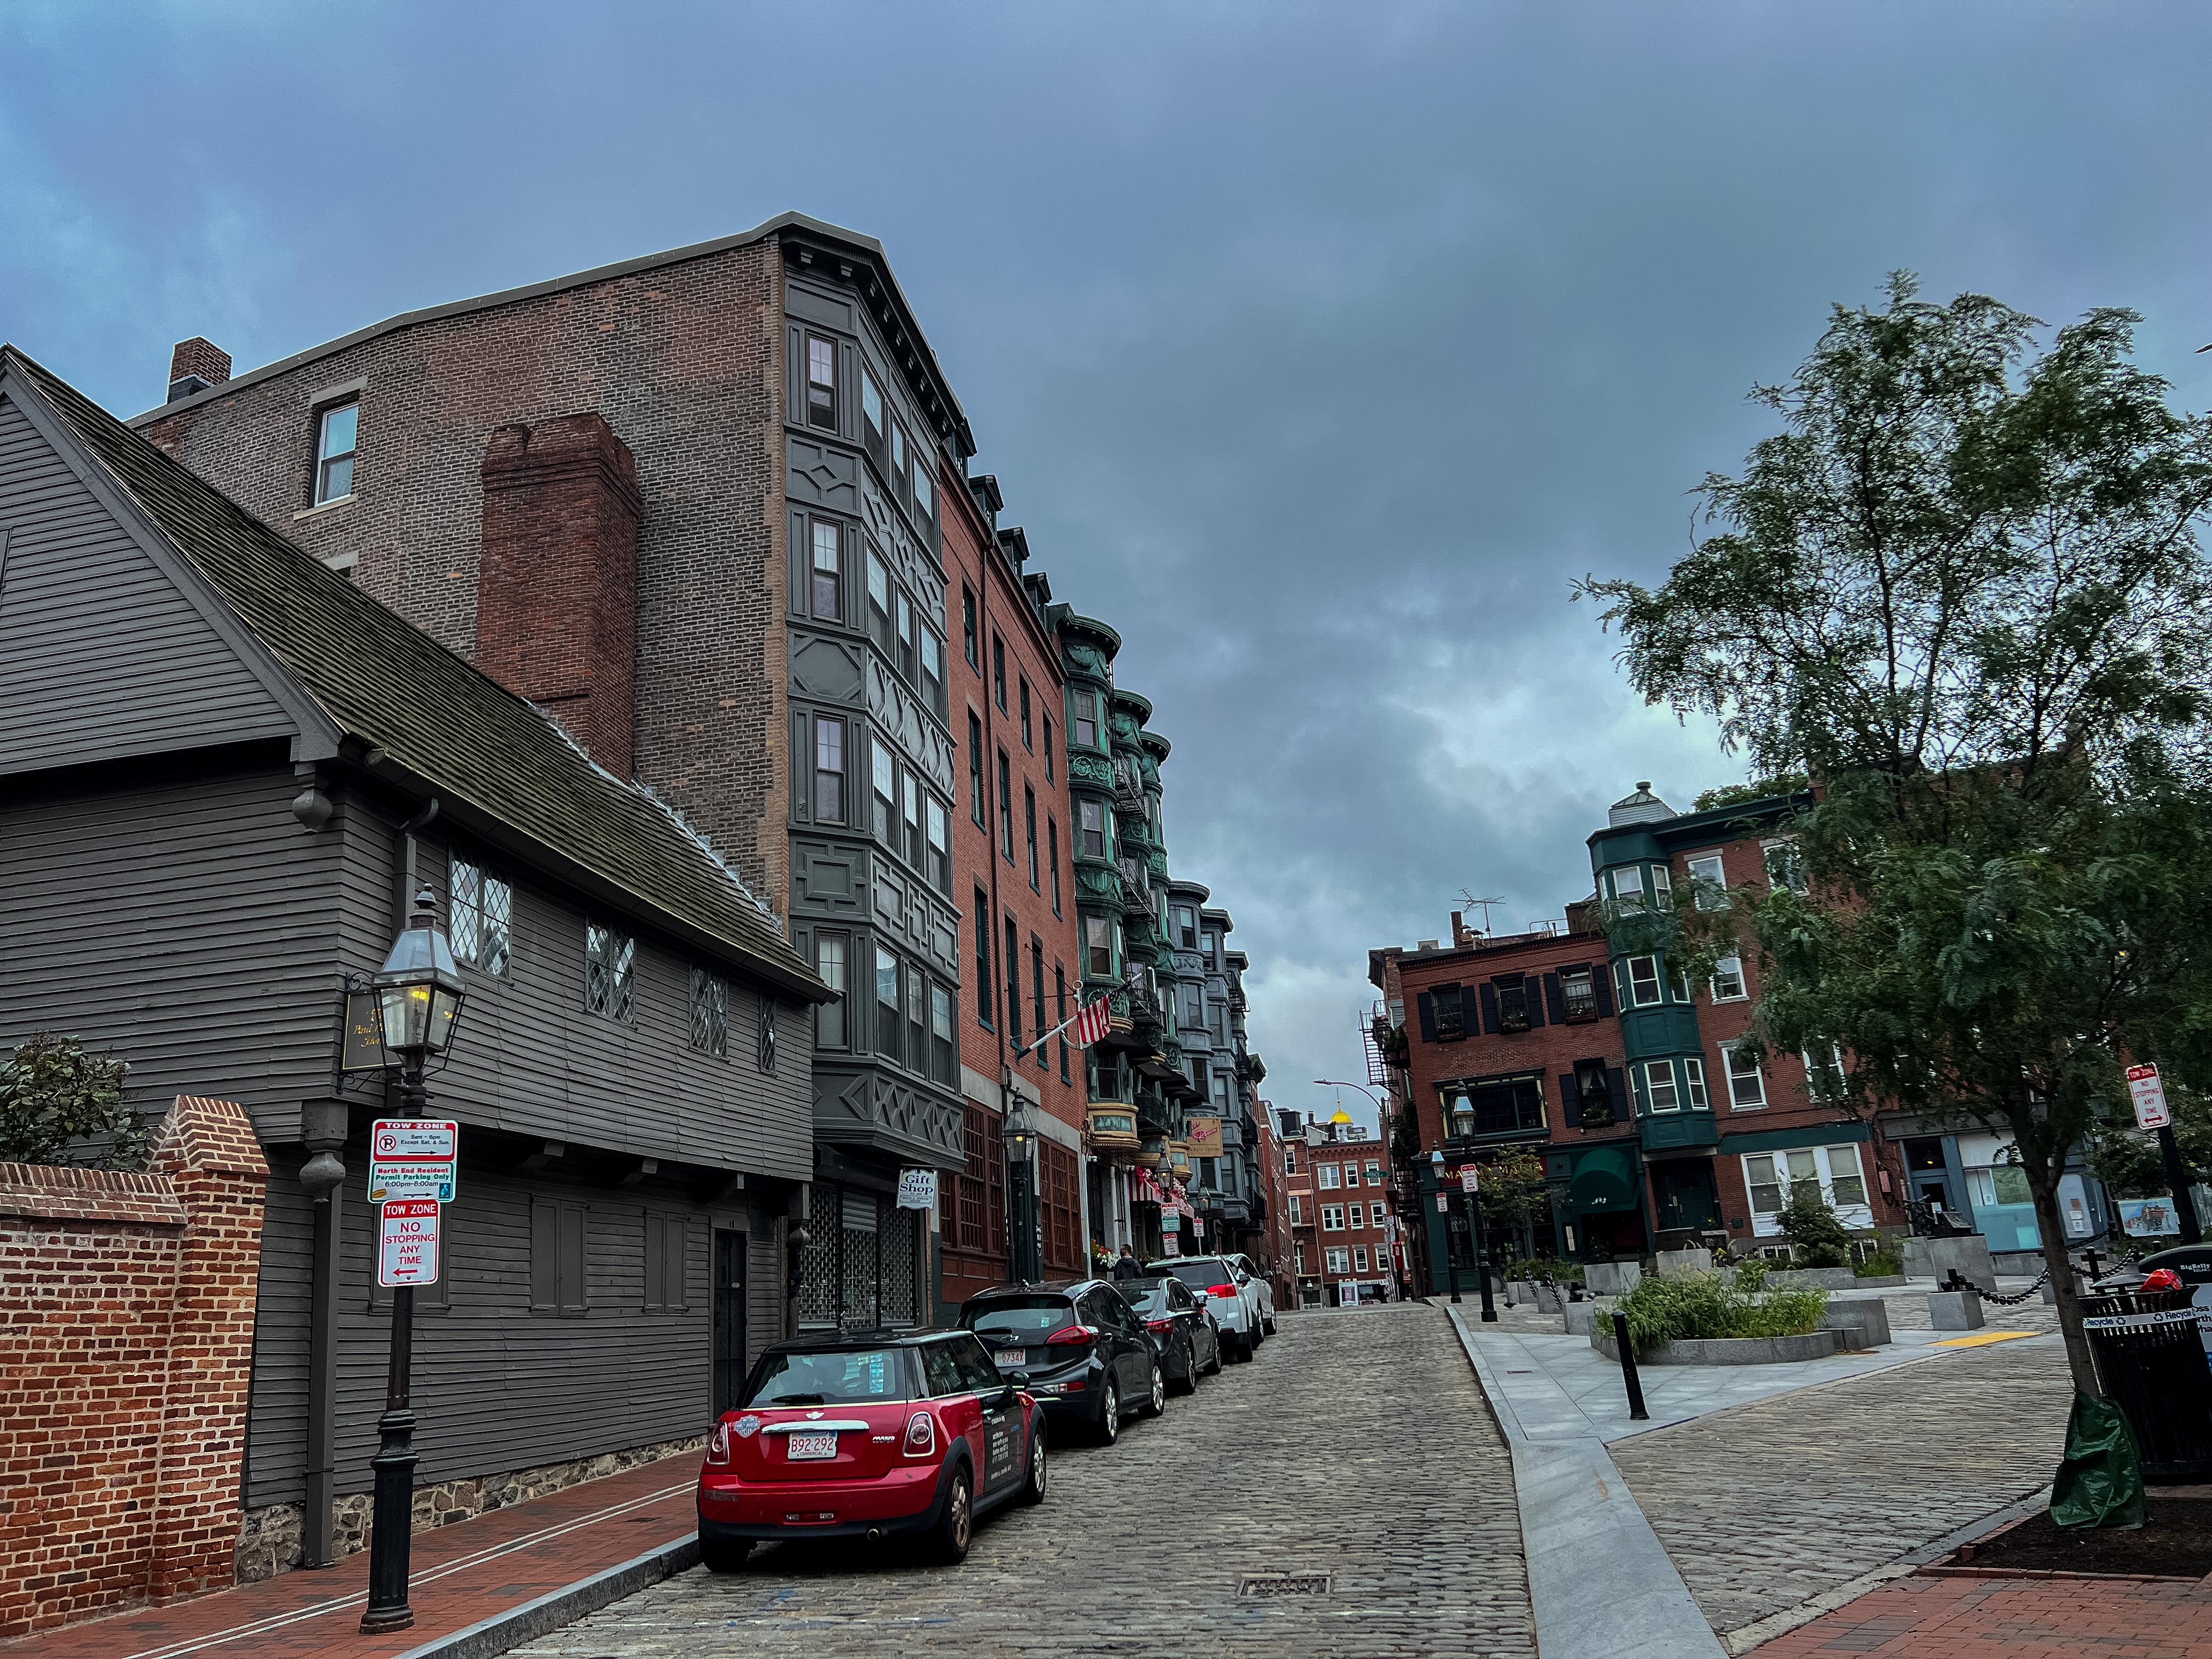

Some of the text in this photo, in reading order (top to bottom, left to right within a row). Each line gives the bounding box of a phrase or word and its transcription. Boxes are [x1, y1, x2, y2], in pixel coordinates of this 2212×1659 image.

[2135, 1088, 2159, 1098] STOPPING
[905, 1175, 930, 1184] Gift
[900, 1183, 933, 1195] Shop
[386, 1204, 436, 1215] TOW ZONE
[400, 1222, 421, 1233] NO
[385, 1234, 435, 1244] STOPPING
[399, 1245, 420, 1254] ANY
[398, 1256, 421, 1265] TIME
[2165, 1311, 2192, 1320] Recycle
[2087, 1318, 2113, 1327] Recycle
